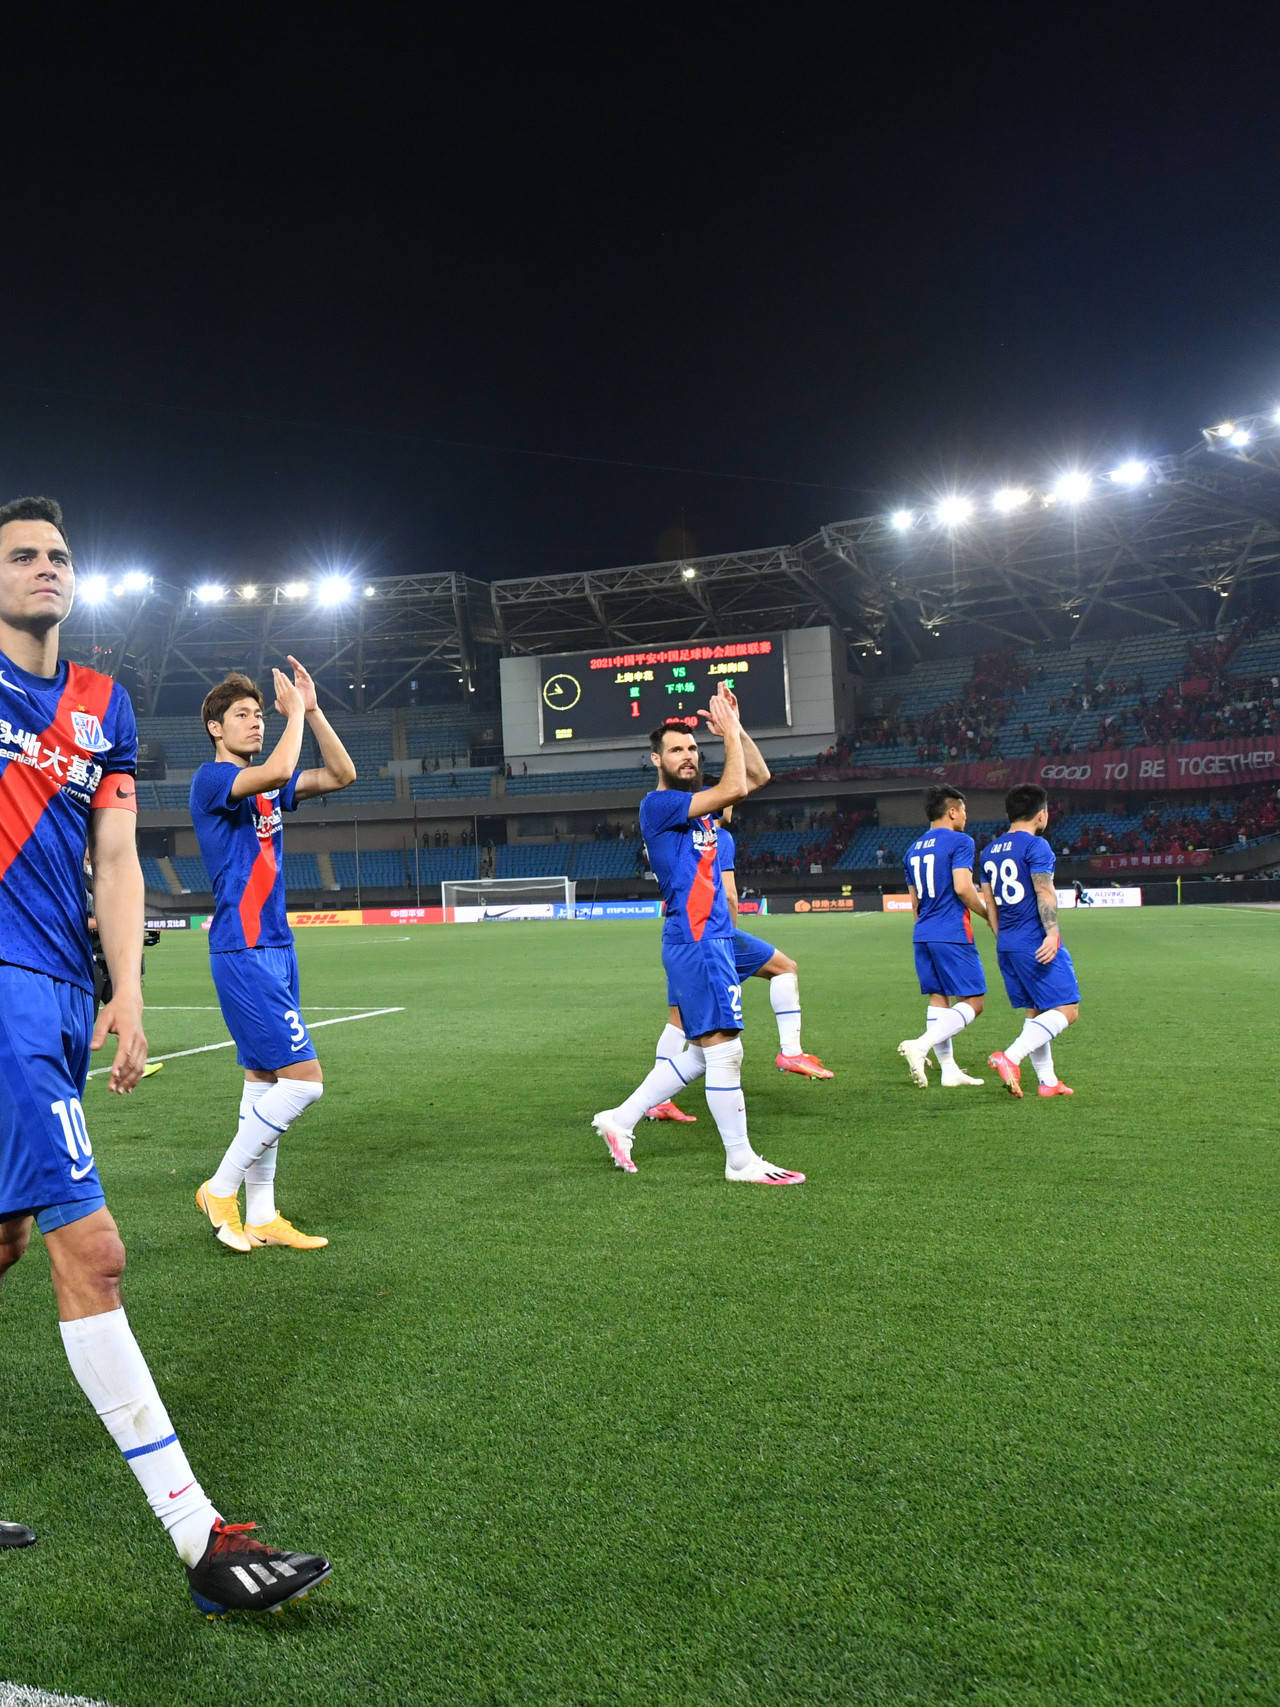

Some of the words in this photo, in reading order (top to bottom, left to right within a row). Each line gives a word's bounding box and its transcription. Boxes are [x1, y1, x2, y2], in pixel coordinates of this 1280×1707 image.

[589, 640, 772, 670] 2021中国平安中国足球协会超级联赛
[672, 666, 687, 678] VS
[665, 682, 695, 694] 下半场
[631, 701, 640, 717] 1
[1040, 765, 1091, 780] GOOD
[1103, 763, 1128, 780] TO
[1139, 759, 1166, 778] BE
[1177, 751, 1280, 776] TOGETHER
[909, 853, 936, 900] 11
[983, 858, 1025, 906] 28
[296, 914, 340, 925] DHL
[284, 1010, 305, 1042] 3
[50, 1097, 93, 1160] 10
